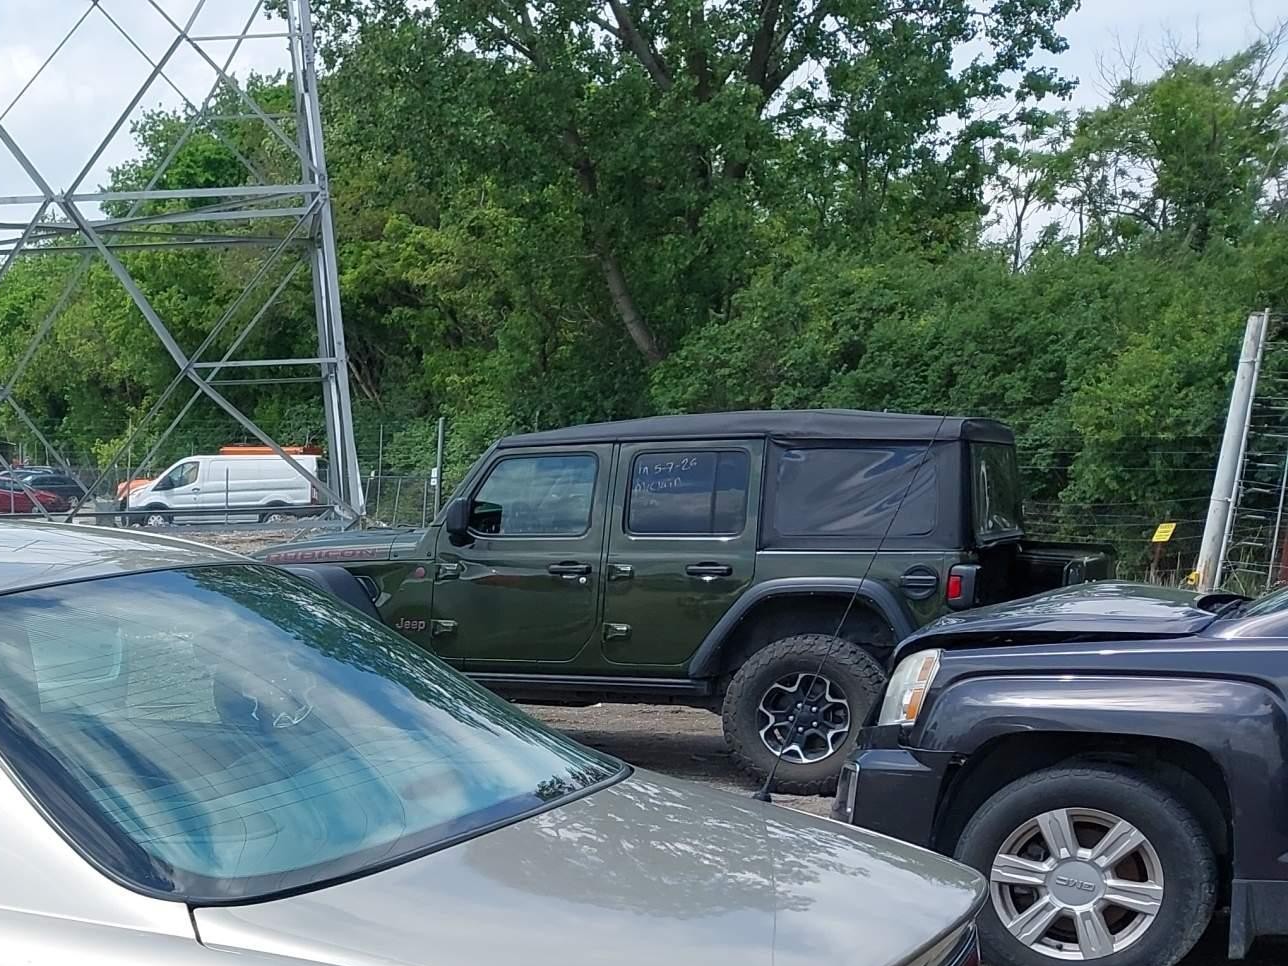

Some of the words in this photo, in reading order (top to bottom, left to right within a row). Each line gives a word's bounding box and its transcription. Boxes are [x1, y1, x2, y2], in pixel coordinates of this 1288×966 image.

[266, 547, 377, 564] RUBICON
[395, 617, 426, 632] Jeep
[1055, 875, 1096, 892] GMC
